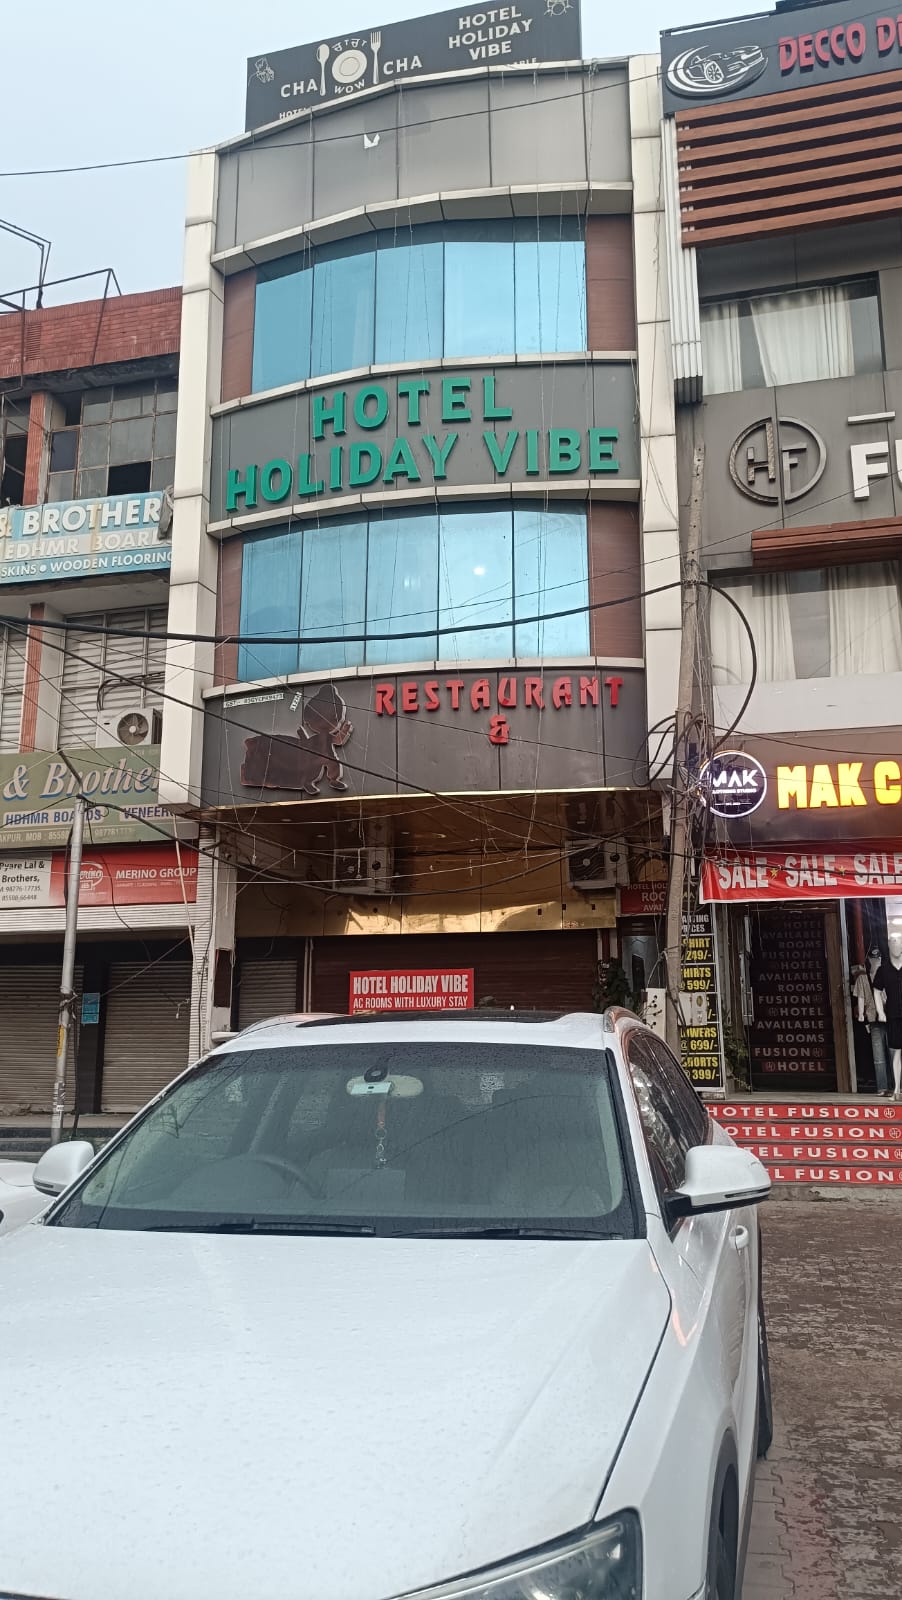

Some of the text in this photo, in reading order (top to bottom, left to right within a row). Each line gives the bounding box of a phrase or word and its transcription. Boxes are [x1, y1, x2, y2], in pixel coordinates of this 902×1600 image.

[458, 5, 521, 30] HOTEL
[448, 18, 533, 49] HOLIDAY
[469, 40, 512, 60] VIBE
[778, 23, 866, 73] DECCO
[280, 55, 423, 98] CHA CHA
[334, 79, 365, 94] WOW
[279, 107, 307, 120] HOTE
[312, 375, 513, 441] HOTEL
[226, 427, 620, 511] HOLIDAY VIBE
[850, 438, 902, 499] F
[22, 497, 162, 536] BROTHER
[1, 564, 37, 578] SKINS
[50, 557, 108, 573] WOODEN
[375, 676, 624, 716] RESTAURANT
[489, 714, 509, 745] &
[3, 764, 29, 801] &
[777, 762, 868, 809] MAK
[5, 806, 173, 825] HDHMR BOADS VENEER
[24, 861, 37, 869] Lal
[116, 869, 157, 880] MERINO
[160, 867, 196, 878] GROUP
[719, 857, 769, 890] SALE
[785, 855, 837, 888] SALE
[2, 875, 40, 884] Brothers,
[781, 961, 822, 969] HOTEL
[682, 968, 711, 978] HIRTS
[759, 972, 823, 982] AVAILABLE
[353, 974, 468, 995] HOTEL HOLIDAY VIBE
[778, 983, 823, 992] ROOMS
[353, 995, 468, 1009] AC ROOMS WITH LUXURY STAY
[758, 995, 811, 1005] FUSION
[779, 1007, 824, 1017] HOTEL
[757, 1020, 825, 1029] AVAILABLE
[690, 1040, 718, 1050] 699/-
[777, 1034, 825, 1043] ROOMS
[754, 1047, 811, 1057] FUSION
[777, 1061, 824, 1072] HOTEL
[692, 1069, 720, 1080] 399/-
[705, 1106, 778, 1117] HOTEL
[788, 1107, 879, 1118] FUSION
[723, 1126, 781, 1137] OTEL
[791, 1127, 884, 1138] FUSION
[793, 1147, 889, 1159] FUSION
[795, 1168, 894, 1181] FUSION
